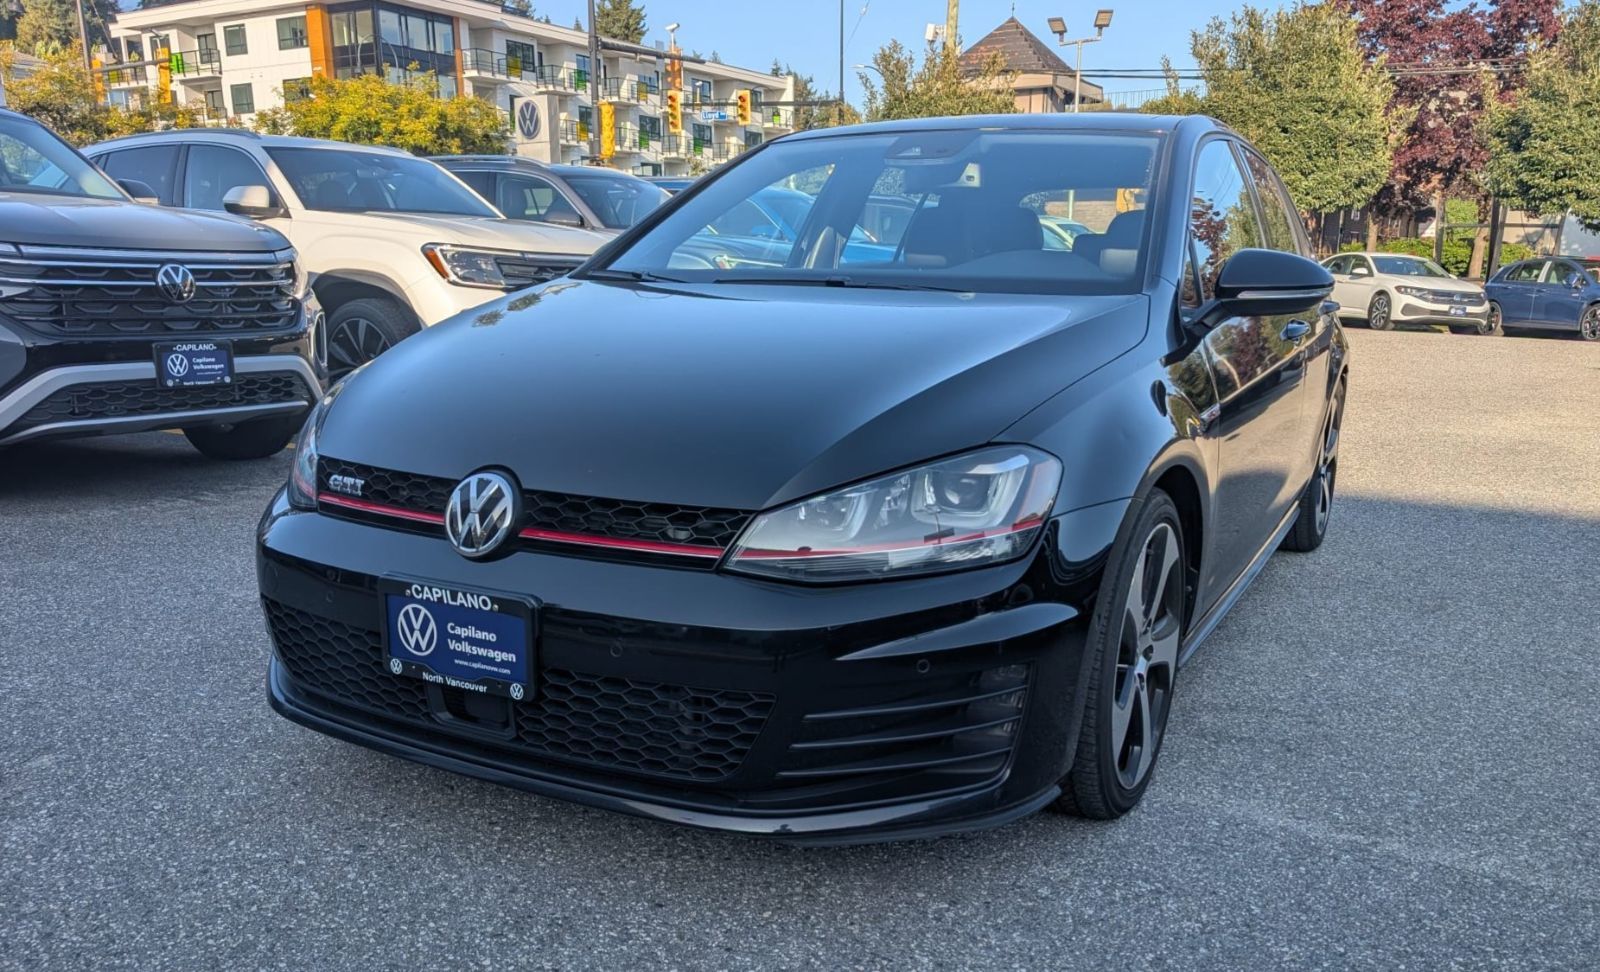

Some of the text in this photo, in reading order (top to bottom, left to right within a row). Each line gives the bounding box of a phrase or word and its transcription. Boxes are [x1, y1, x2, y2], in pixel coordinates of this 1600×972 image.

[176, 343, 214, 351] CAPILANO
[167, 353, 189, 377] VW
[328, 474, 365, 496] GTI
[411, 584, 491, 611] CAPILANO
[397, 603, 437, 656] VW
[447, 622, 497, 642] Capilano
[447, 638, 517, 663] Volkswagen
[422, 671, 488, 693] North Vancouver
